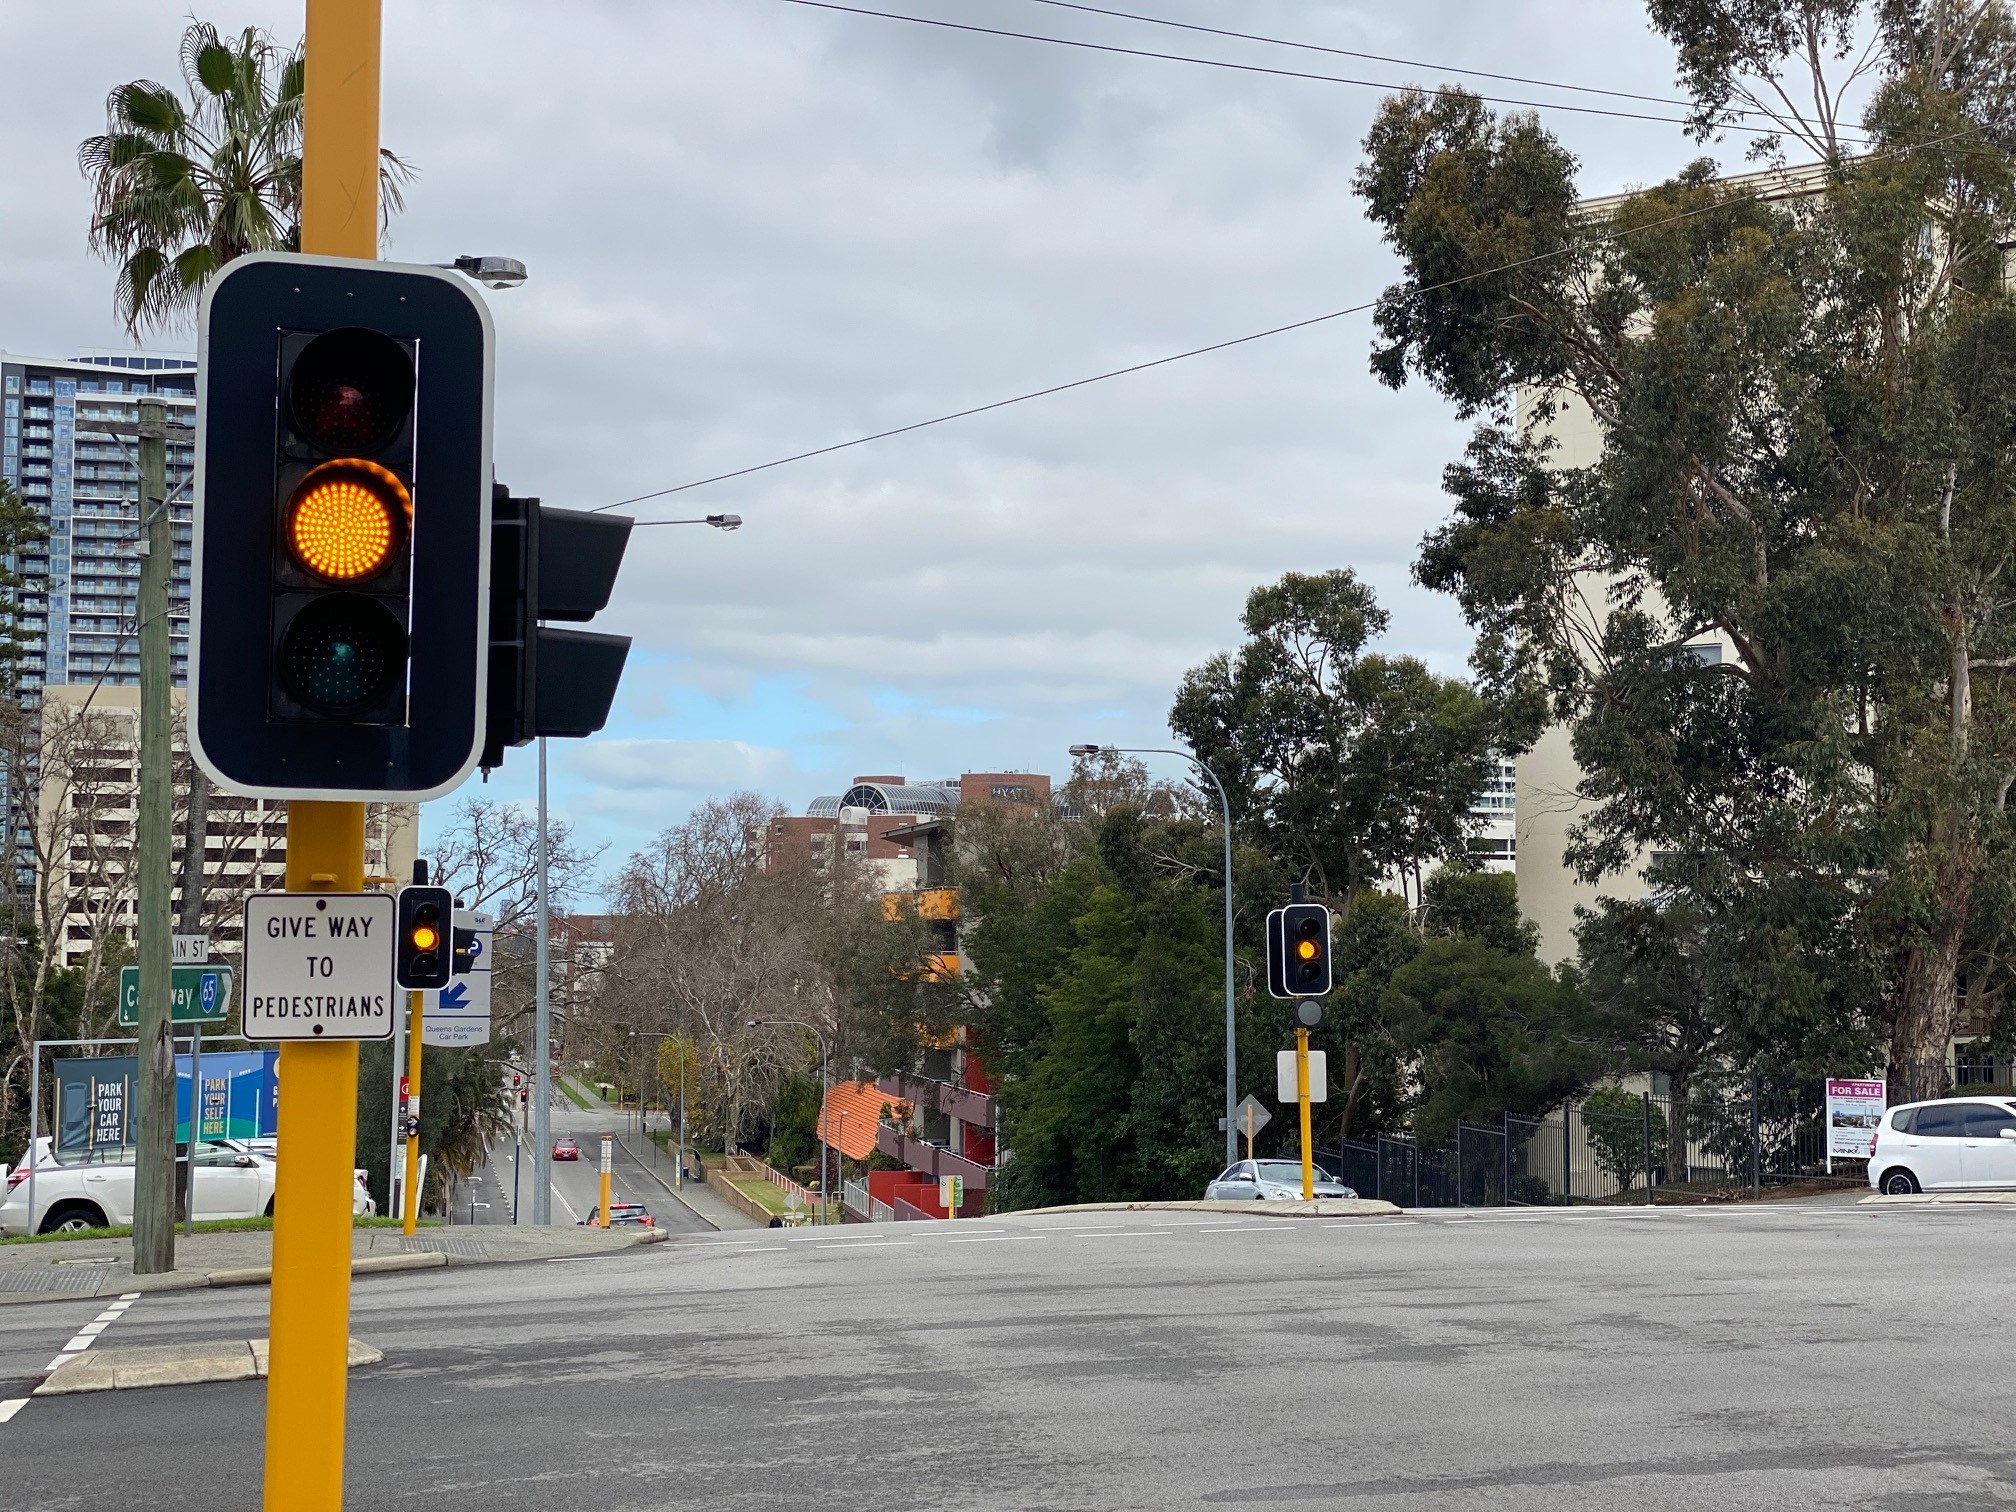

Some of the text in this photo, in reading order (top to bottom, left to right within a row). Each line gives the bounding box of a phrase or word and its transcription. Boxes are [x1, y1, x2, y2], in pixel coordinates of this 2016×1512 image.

[267, 916, 373, 938] GIVE WAY
[192, 940, 205, 957] ST
[306, 956, 334, 978] TO
[203, 980, 214, 1002] 65
[253, 995, 384, 1018] PEDESTRIANS
[425, 1025, 483, 1033] Queens Gardens
[98, 1082, 123, 1097] PARK
[204, 1078, 226, 1092] PARK
[1831, 1086, 1881, 1096] FOR SALE
[97, 1097, 122, 1112] YOUR
[204, 1093, 226, 1107] YOUR
[99, 1113, 118, 1127] CAR
[204, 1107, 224, 1121] SELF
[96, 1127, 120, 1142] HERE
[203, 1121, 225, 1135] HERE
